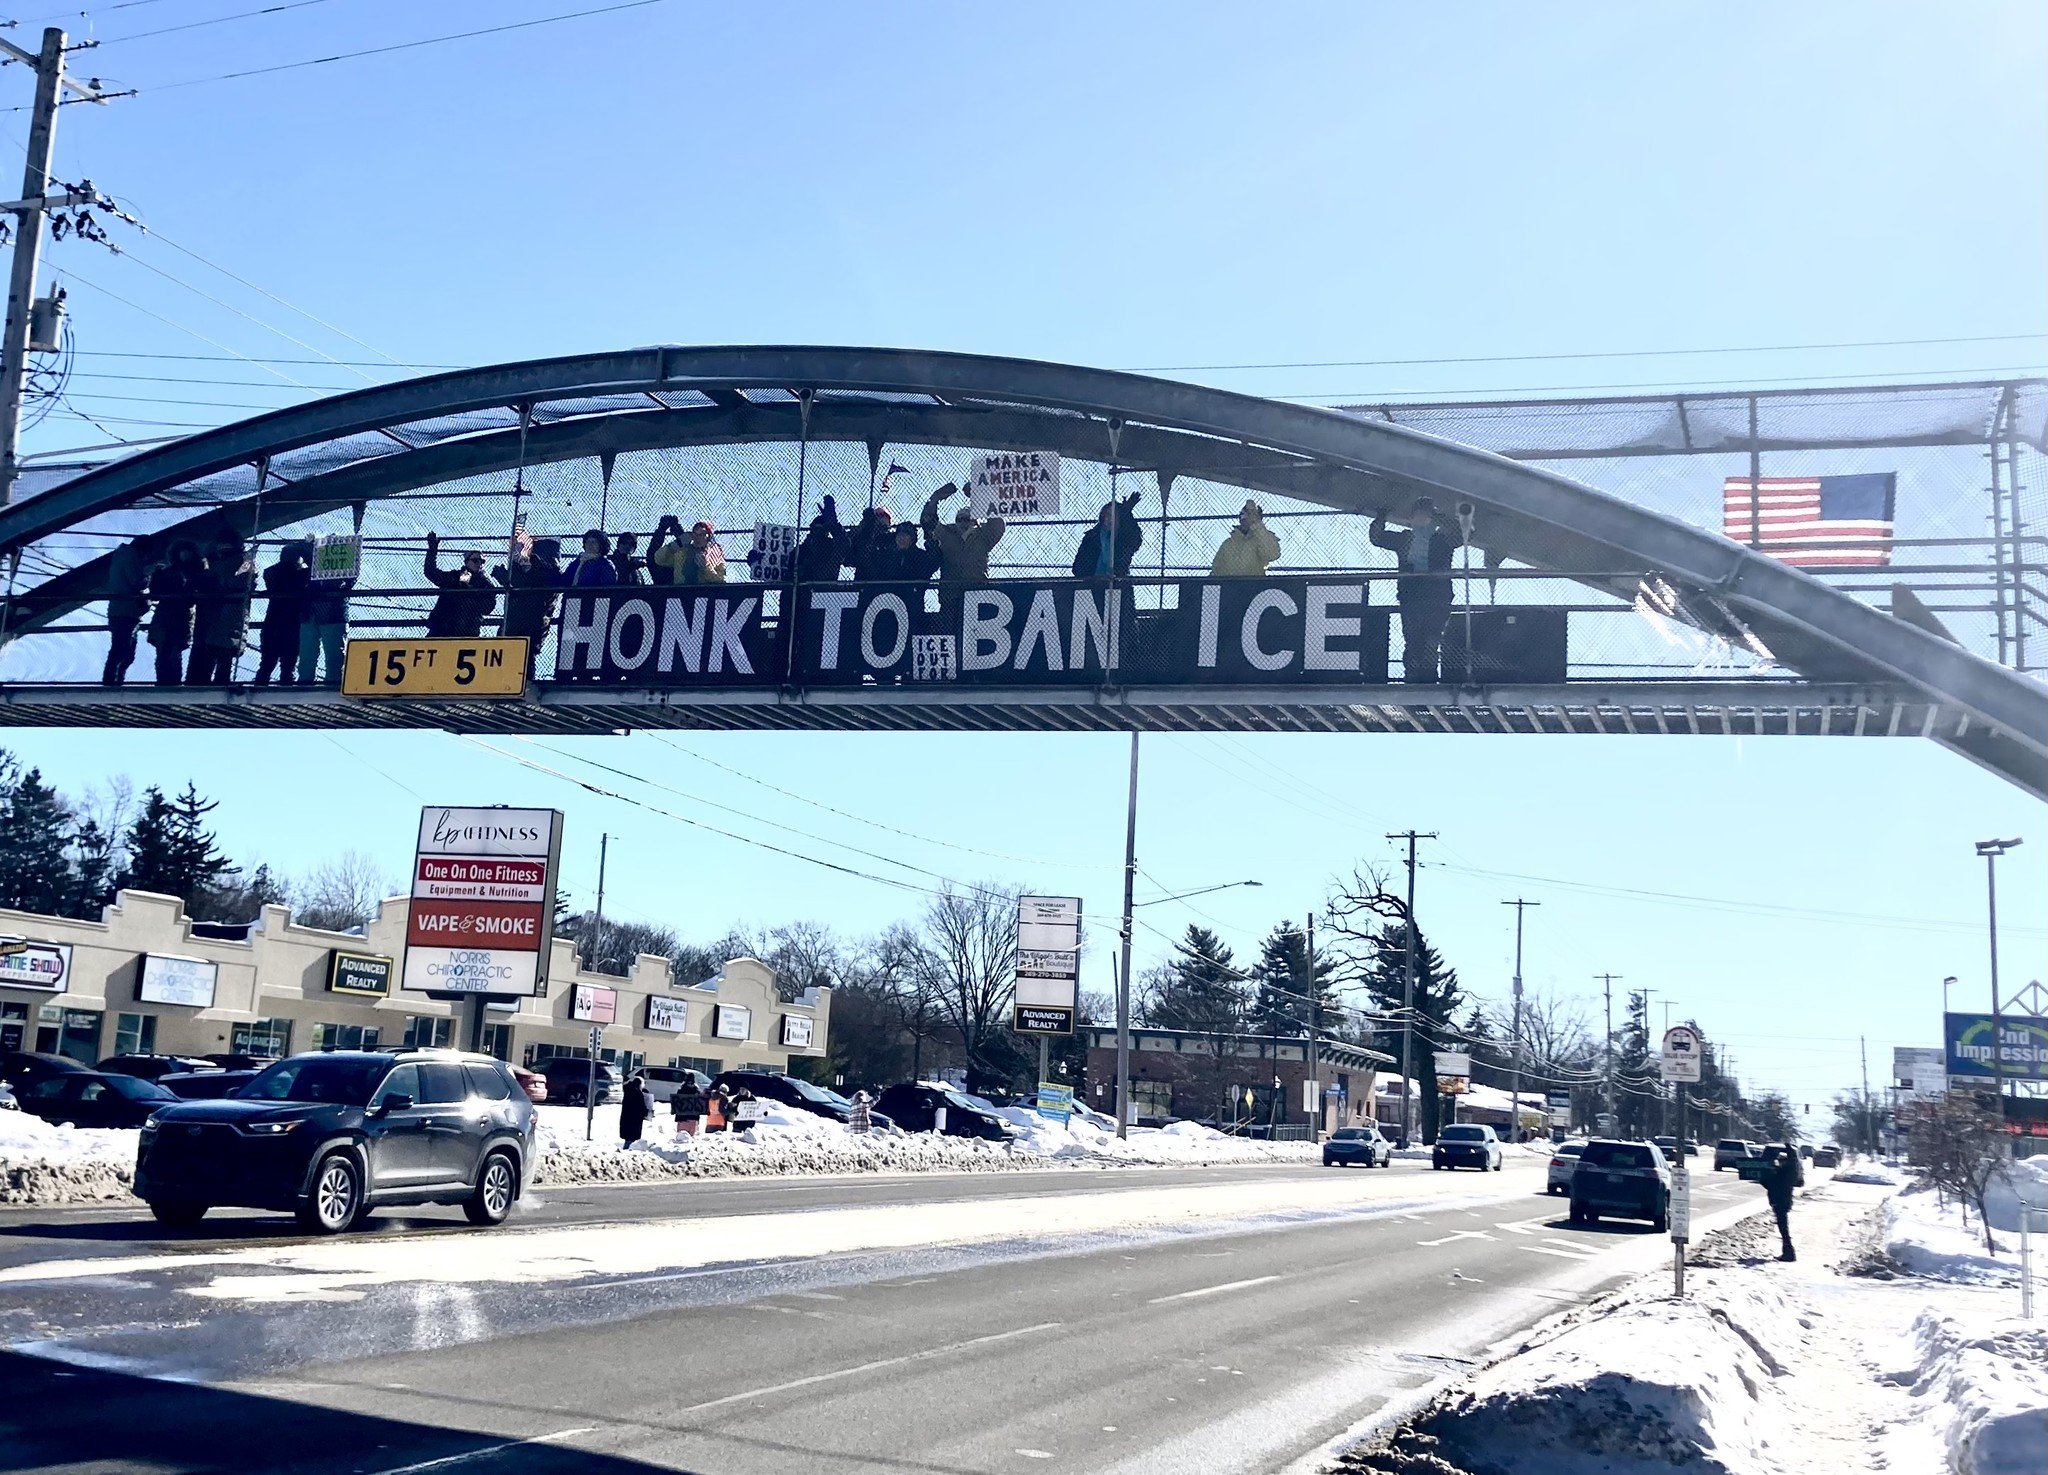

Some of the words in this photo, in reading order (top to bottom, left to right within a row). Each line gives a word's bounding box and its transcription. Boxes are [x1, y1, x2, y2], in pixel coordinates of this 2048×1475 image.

[986, 453, 1041, 469] MAKE
[978, 468, 1051, 486] AMERICA
[999, 484, 1036, 499] KIND
[986, 500, 1039, 516] AGAIN
[761, 525, 791, 539] ICE
[325, 544, 348, 556] ICE
[758, 538, 790, 553] OUT
[322, 559, 349, 570] OUT
[558, 597, 758, 674] HONK
[810, 591, 910, 671] TO
[962, 588, 1122, 671] BAN
[1197, 584, 1364, 671] ICE
[918, 638, 949, 652] ICE
[368, 650, 406, 686] 15
[413, 649, 438, 668] FT
[454, 649, 477, 686] 5
[483, 648, 503, 668] IN
[916, 652, 951, 667] OUT
[425, 862, 448, 879] One
[450, 863, 467, 879] On
[469, 864, 493, 880] One
[495, 865, 538, 882] Fitness
[429, 883, 476, 896] Equipment
[479, 885, 486, 896] &
[488, 885, 529, 898] Nutrition
[417, 914, 459, 932] VAPE
[475, 917, 535, 935] SMOKE
[0, 954, 27, 970] AME
[449, 951, 491, 965] NORRIS
[340, 958, 387, 975] ADVANCED
[427, 964, 513, 979] CHIROPRACTIC
[346, 974, 378, 989] REALTY
[445, 977, 489, 991] CENTER
[1022, 1009, 1066, 1020] ADVANCED
[1028, 1019, 1058, 1029] REALTY
